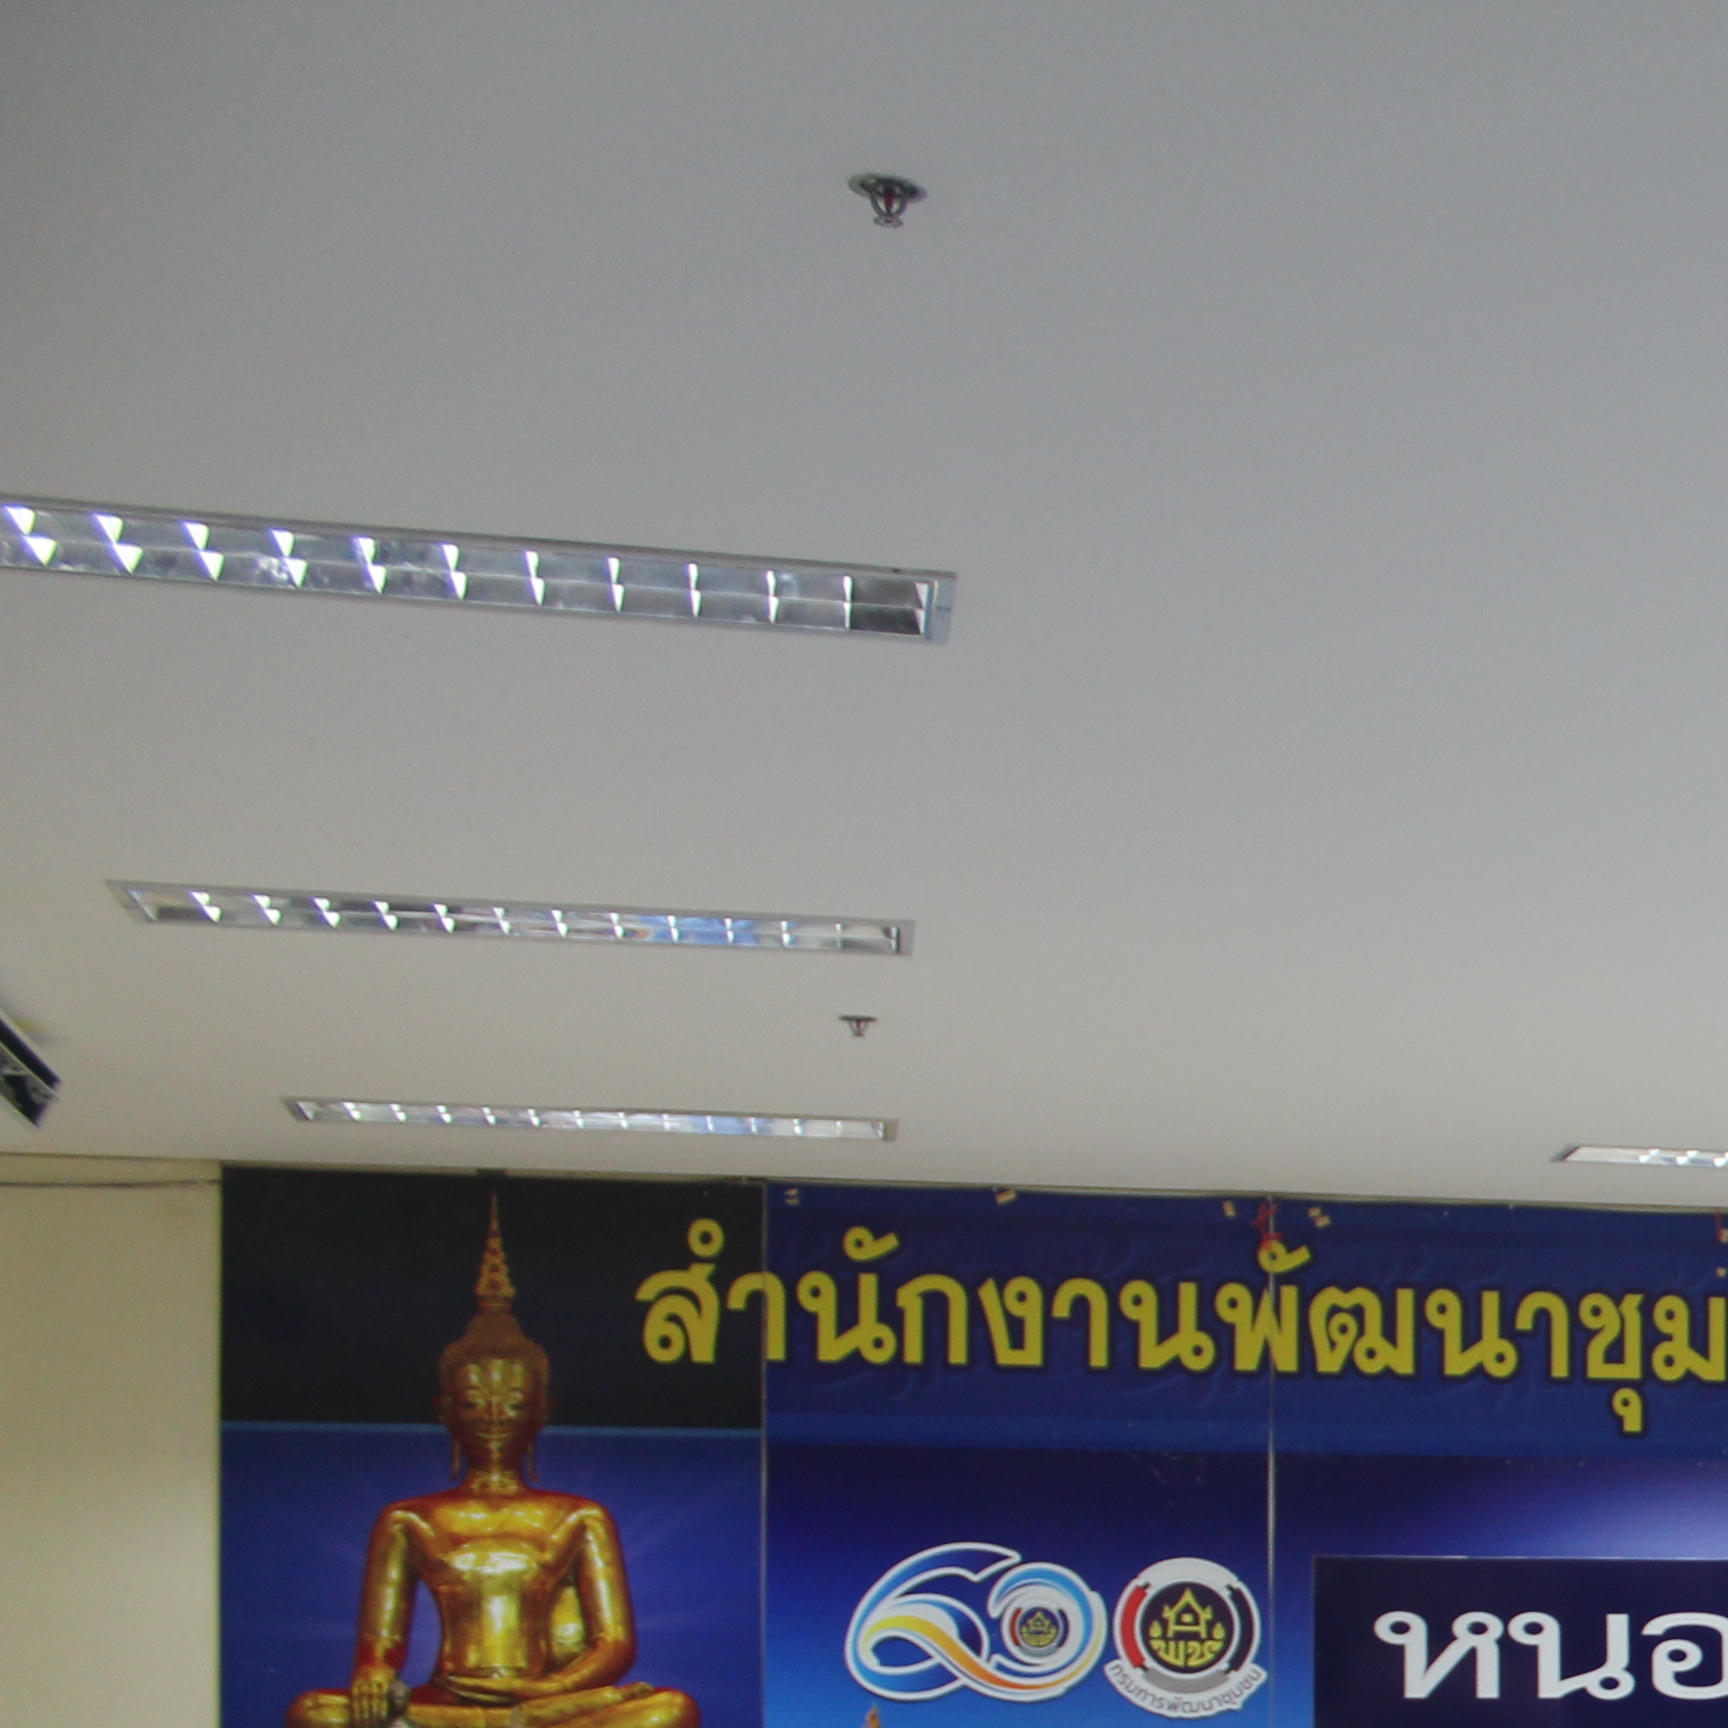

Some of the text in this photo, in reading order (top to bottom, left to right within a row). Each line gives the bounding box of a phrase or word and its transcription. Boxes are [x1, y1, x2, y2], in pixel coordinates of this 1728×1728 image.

[1109, 1663, 1262, 1714] กรมการพัฒนาชุมชน
